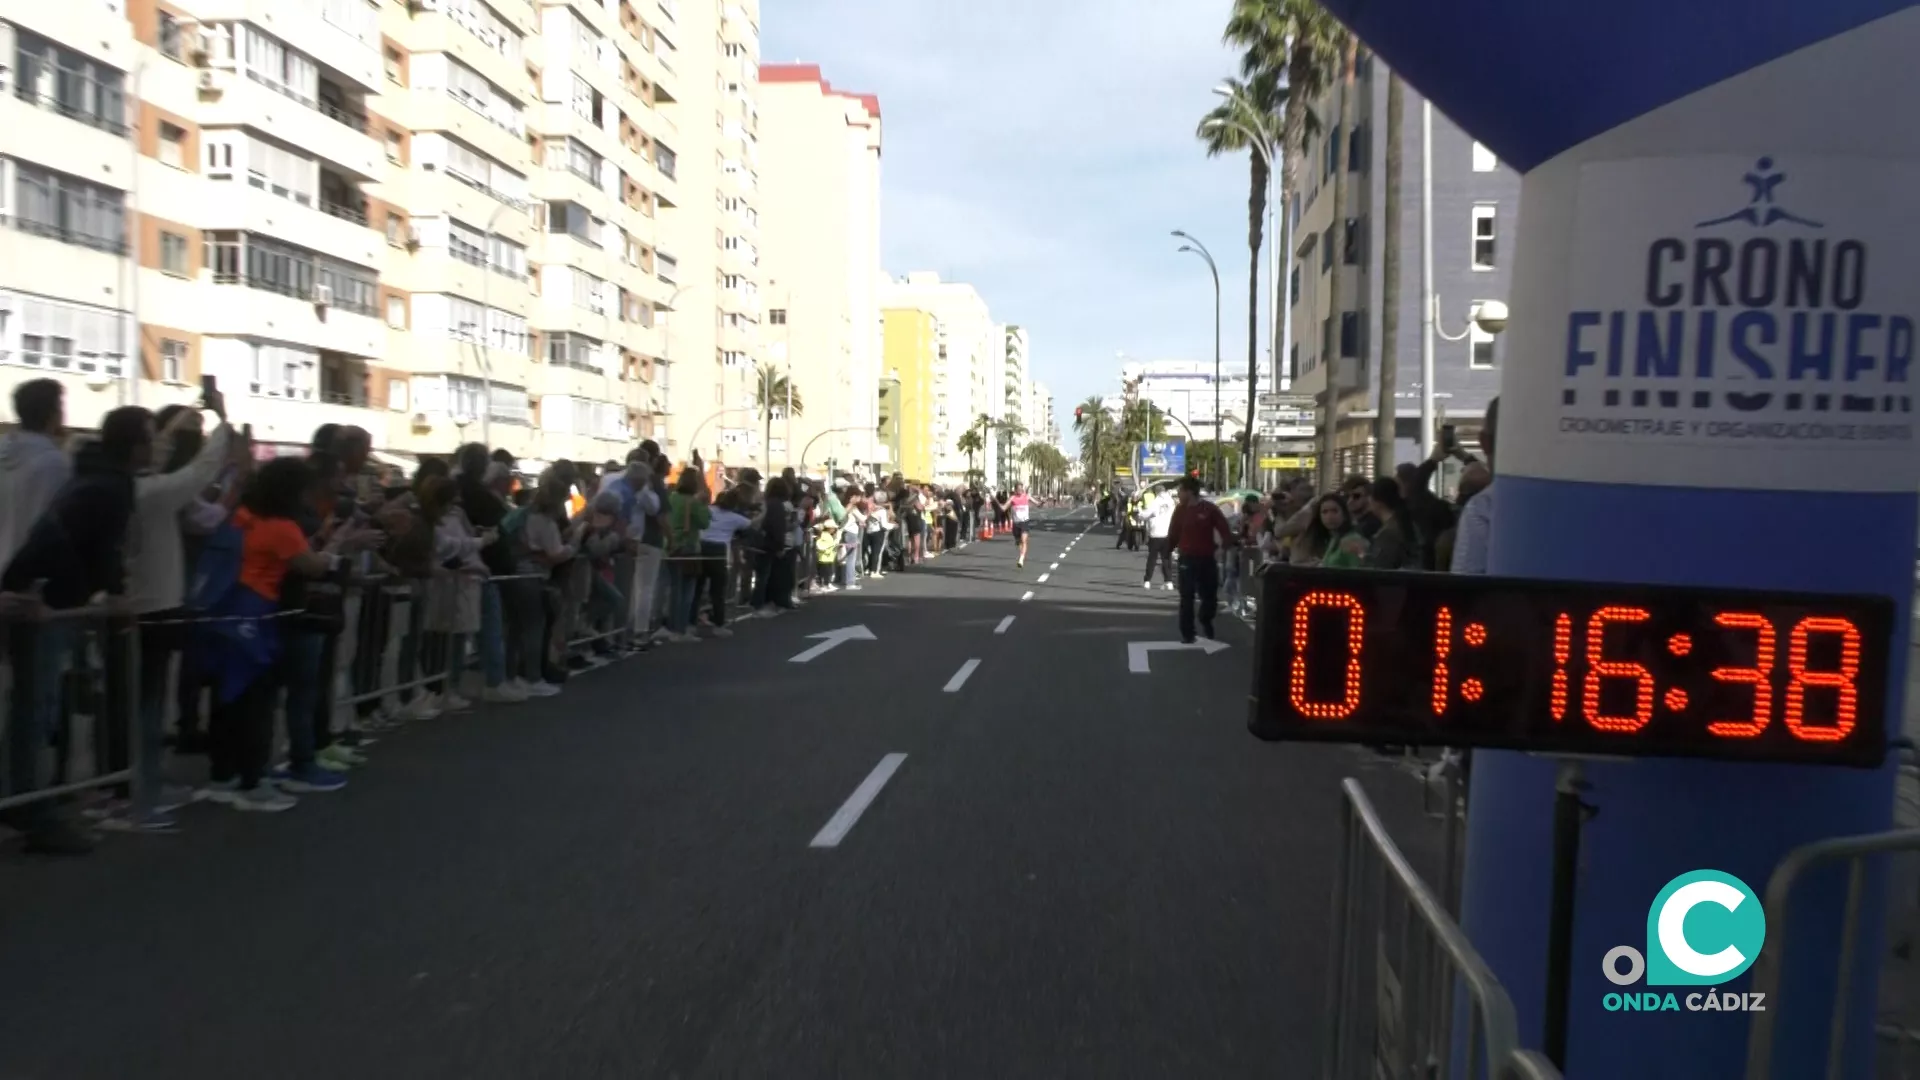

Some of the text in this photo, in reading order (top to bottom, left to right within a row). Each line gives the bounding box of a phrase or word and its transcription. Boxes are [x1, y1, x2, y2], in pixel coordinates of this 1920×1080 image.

[1644, 237, 1866, 310] CRONO
[1561, 310, 1914, 413] FINISHER
[1559, 416, 1684, 436] CRONOMETRAJE
[1690, 419, 1703, 434] Y
